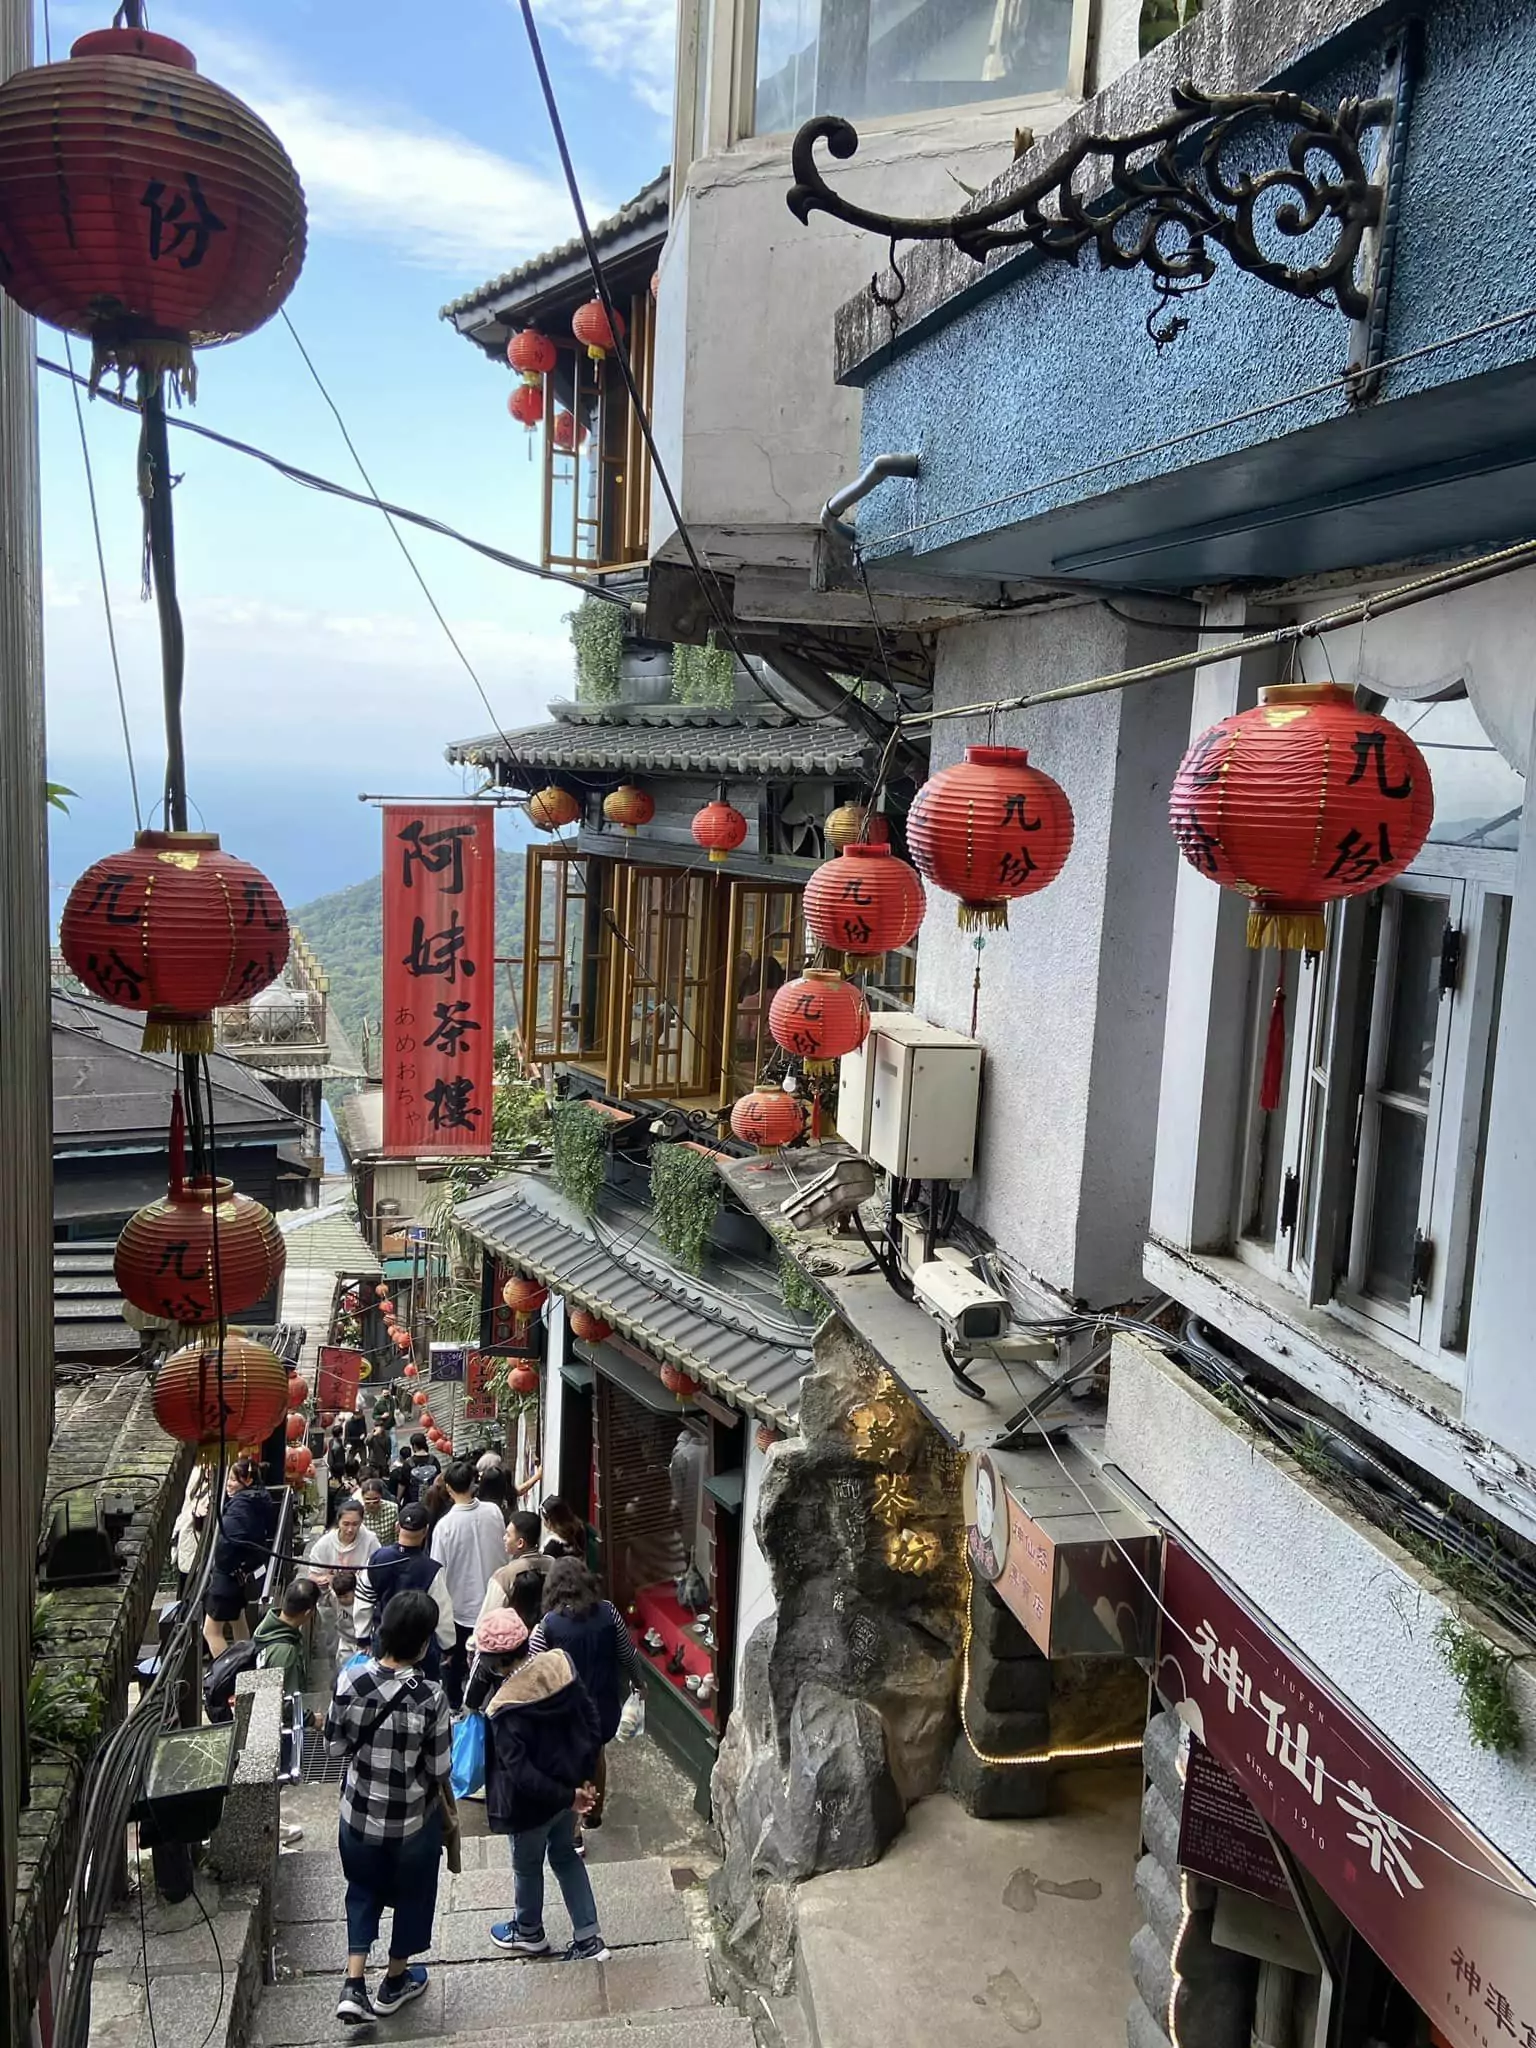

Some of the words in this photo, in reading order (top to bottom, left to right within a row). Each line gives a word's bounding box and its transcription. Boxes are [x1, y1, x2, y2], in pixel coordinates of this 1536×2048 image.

[1000, 794, 1041, 888] 九份
[1323, 730, 1413, 884] 九份
[85, 873, 147, 1002] 九份
[842, 878, 873, 945] 九份
[397, 819, 483, 1132] 阿妹茶樓
[791, 994, 822, 1055] 九份
[155, 1241, 209, 1320] 九份
[1273, 1667, 1326, 1724] JIUFEN
[1191, 1617, 1425, 1898] 神仙茶
[1245, 1752, 1275, 1791] since
[1293, 1807, 1325, 1850] 1910
